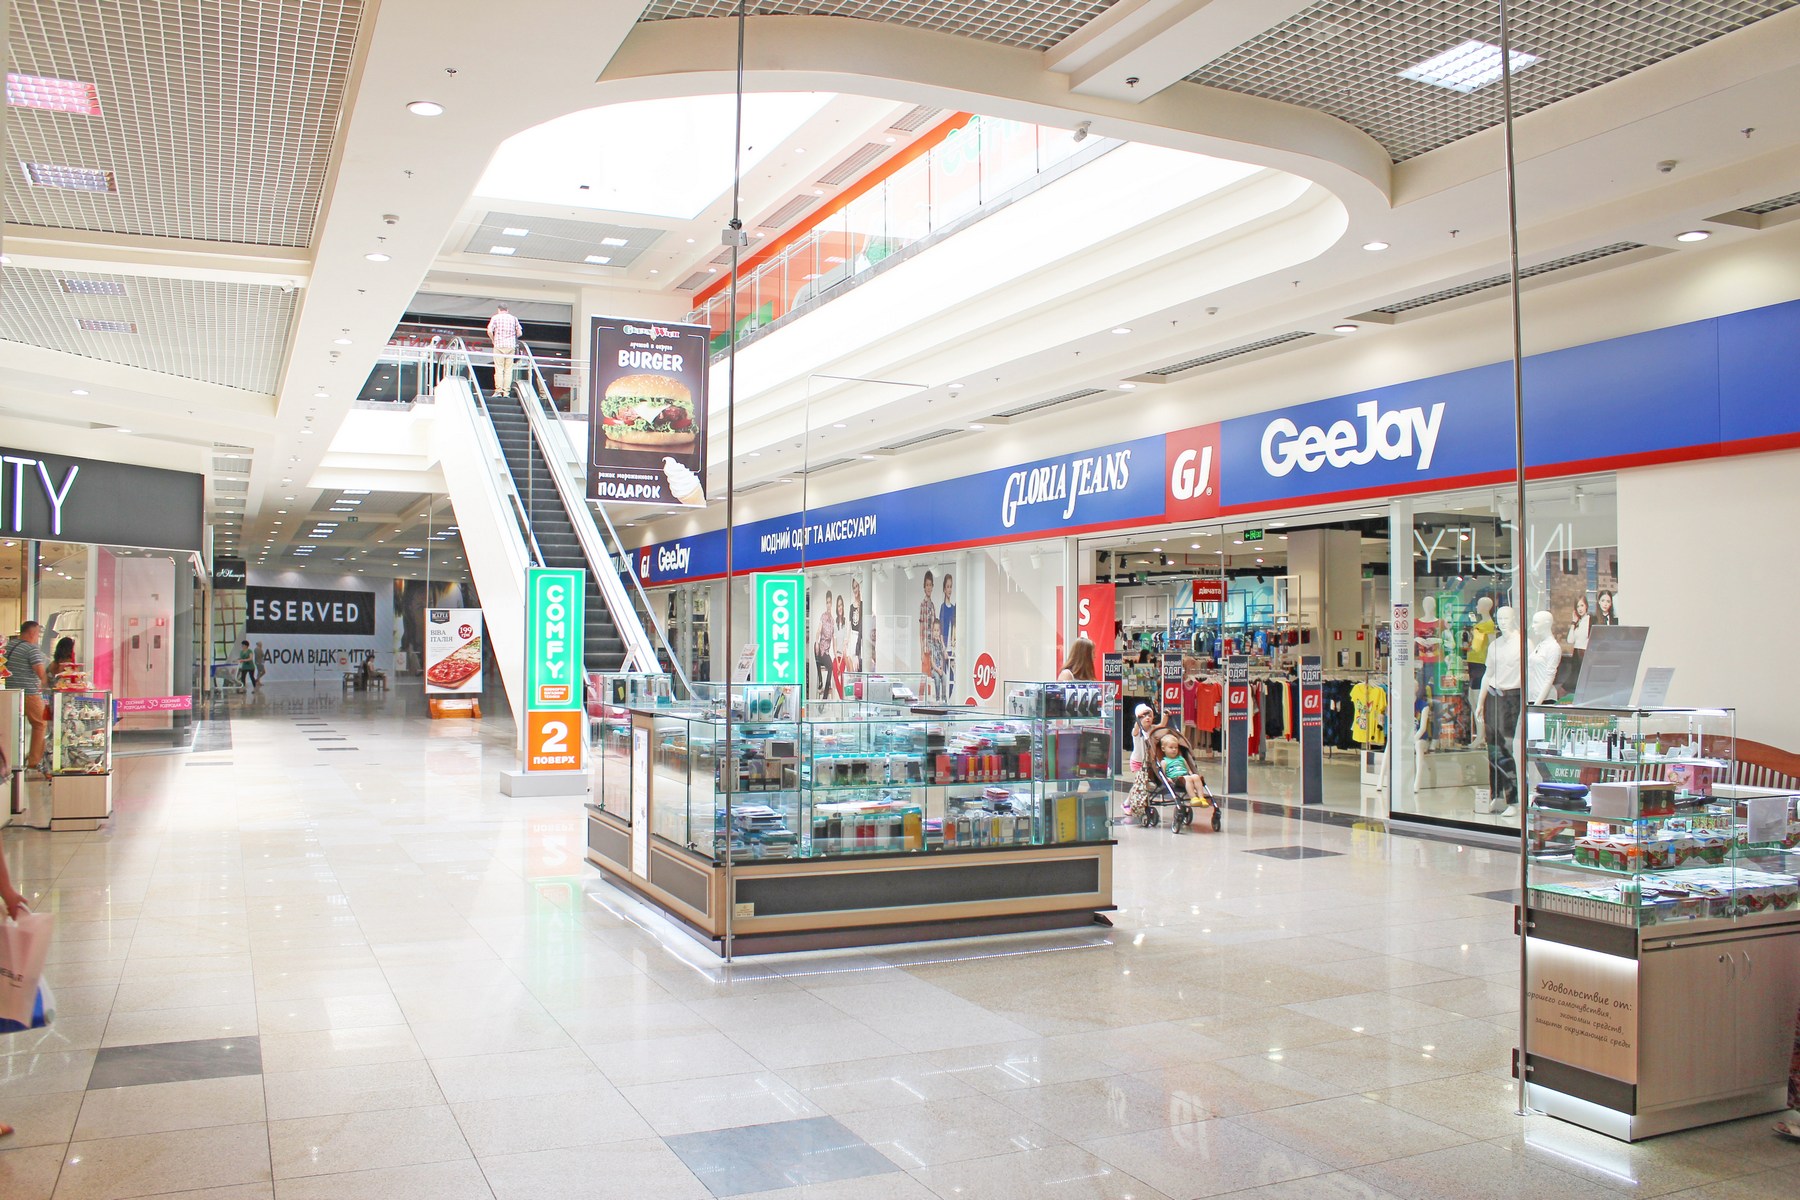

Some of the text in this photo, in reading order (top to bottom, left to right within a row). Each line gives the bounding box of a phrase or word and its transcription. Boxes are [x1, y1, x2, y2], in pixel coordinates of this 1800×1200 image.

[618, 350, 683, 372] BURGER
[1260, 400, 1446, 478] GeeJay
[598, 482, 660, 498] ПОДАРОК
[1002, 450, 1131, 528] GLORIA JEANS
[760, 527, 790, 554] МОДНИЙ
[813, 525, 823, 544] ТА
[825, 514, 876, 542] АКСЕСУАРИ
[658, 544, 690, 574] GeeJay
[246, 599, 359, 623] ESERVED
[546, 584, 565, 679] COMFY
[772, 589, 789, 678] COMFY
[1229, 669, 1247, 678] ОДЯГ
[1302, 671, 1320, 681] ОДЯГ
[1166, 688, 1179, 699] GJ
[1231, 691, 1244, 704] GJ
[1304, 695, 1318, 708] GJ
[541, 721, 568, 753] 2
[533, 756, 575, 764] ПОВЕРХ
[1526, 991, 1612, 1019] орошего самочувствия,
[1541, 979, 1632, 1011] Удовольствие от:
[1560, 1012, 1590, 1025] экономии
[1536, 1017, 1631, 1048] защиты окружающей среды
